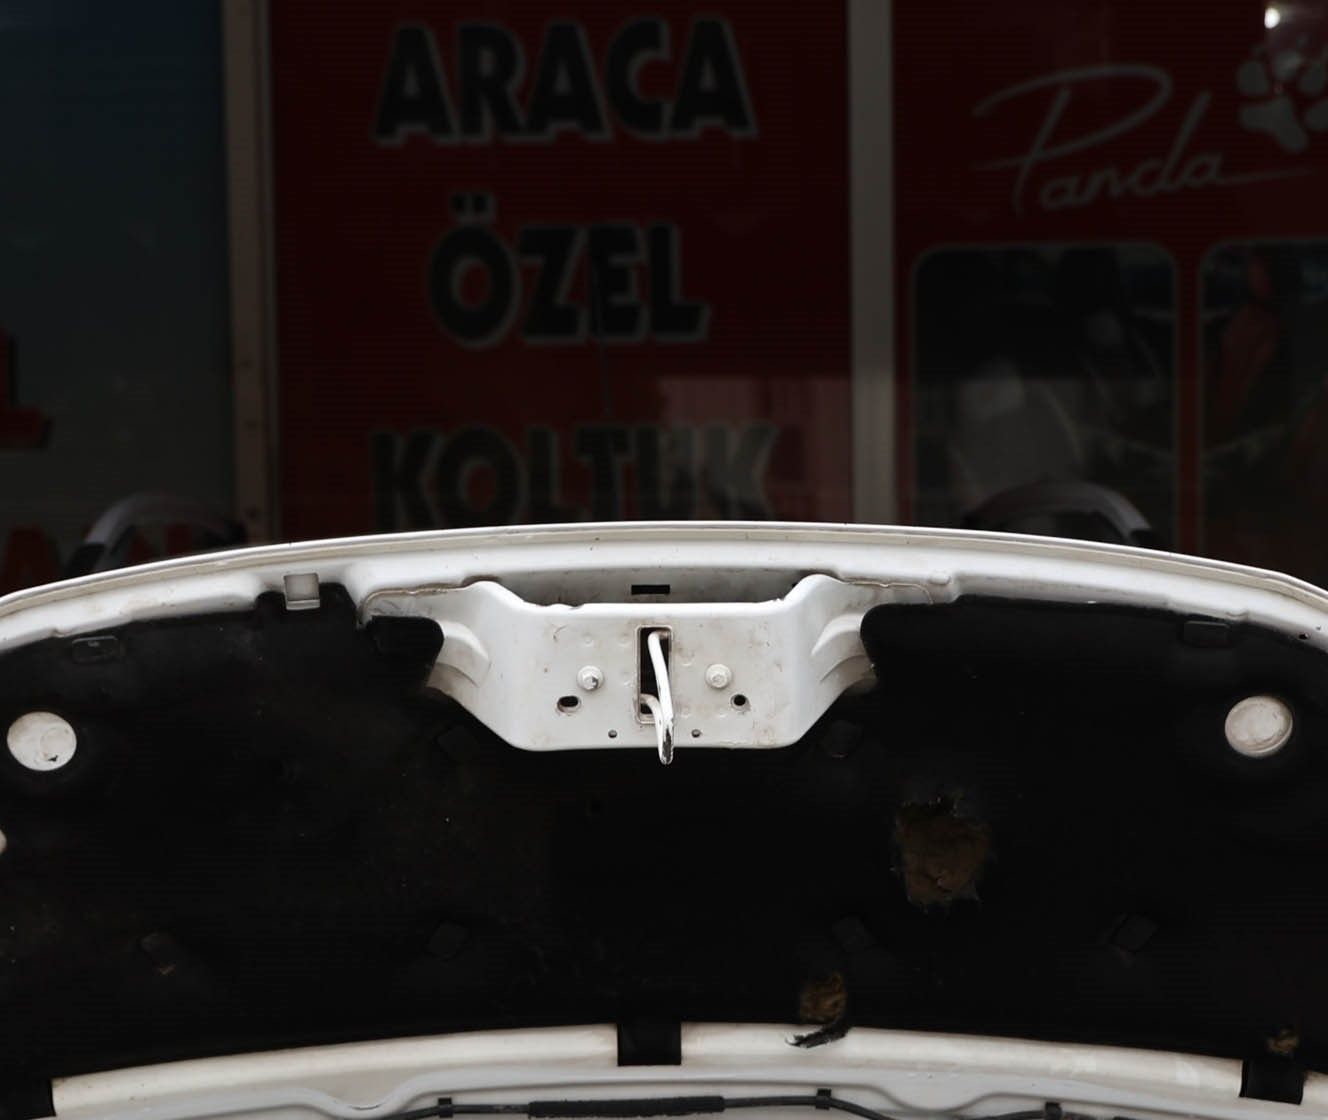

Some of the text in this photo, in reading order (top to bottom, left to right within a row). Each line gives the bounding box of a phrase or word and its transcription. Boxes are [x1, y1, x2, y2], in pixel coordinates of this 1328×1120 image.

[368, 16, 759, 144] ARACA
[970, 61, 1315, 219] Panda
[428, 189, 709, 349] ÖZEL
[370, 420, 779, 531] KOLTUK
